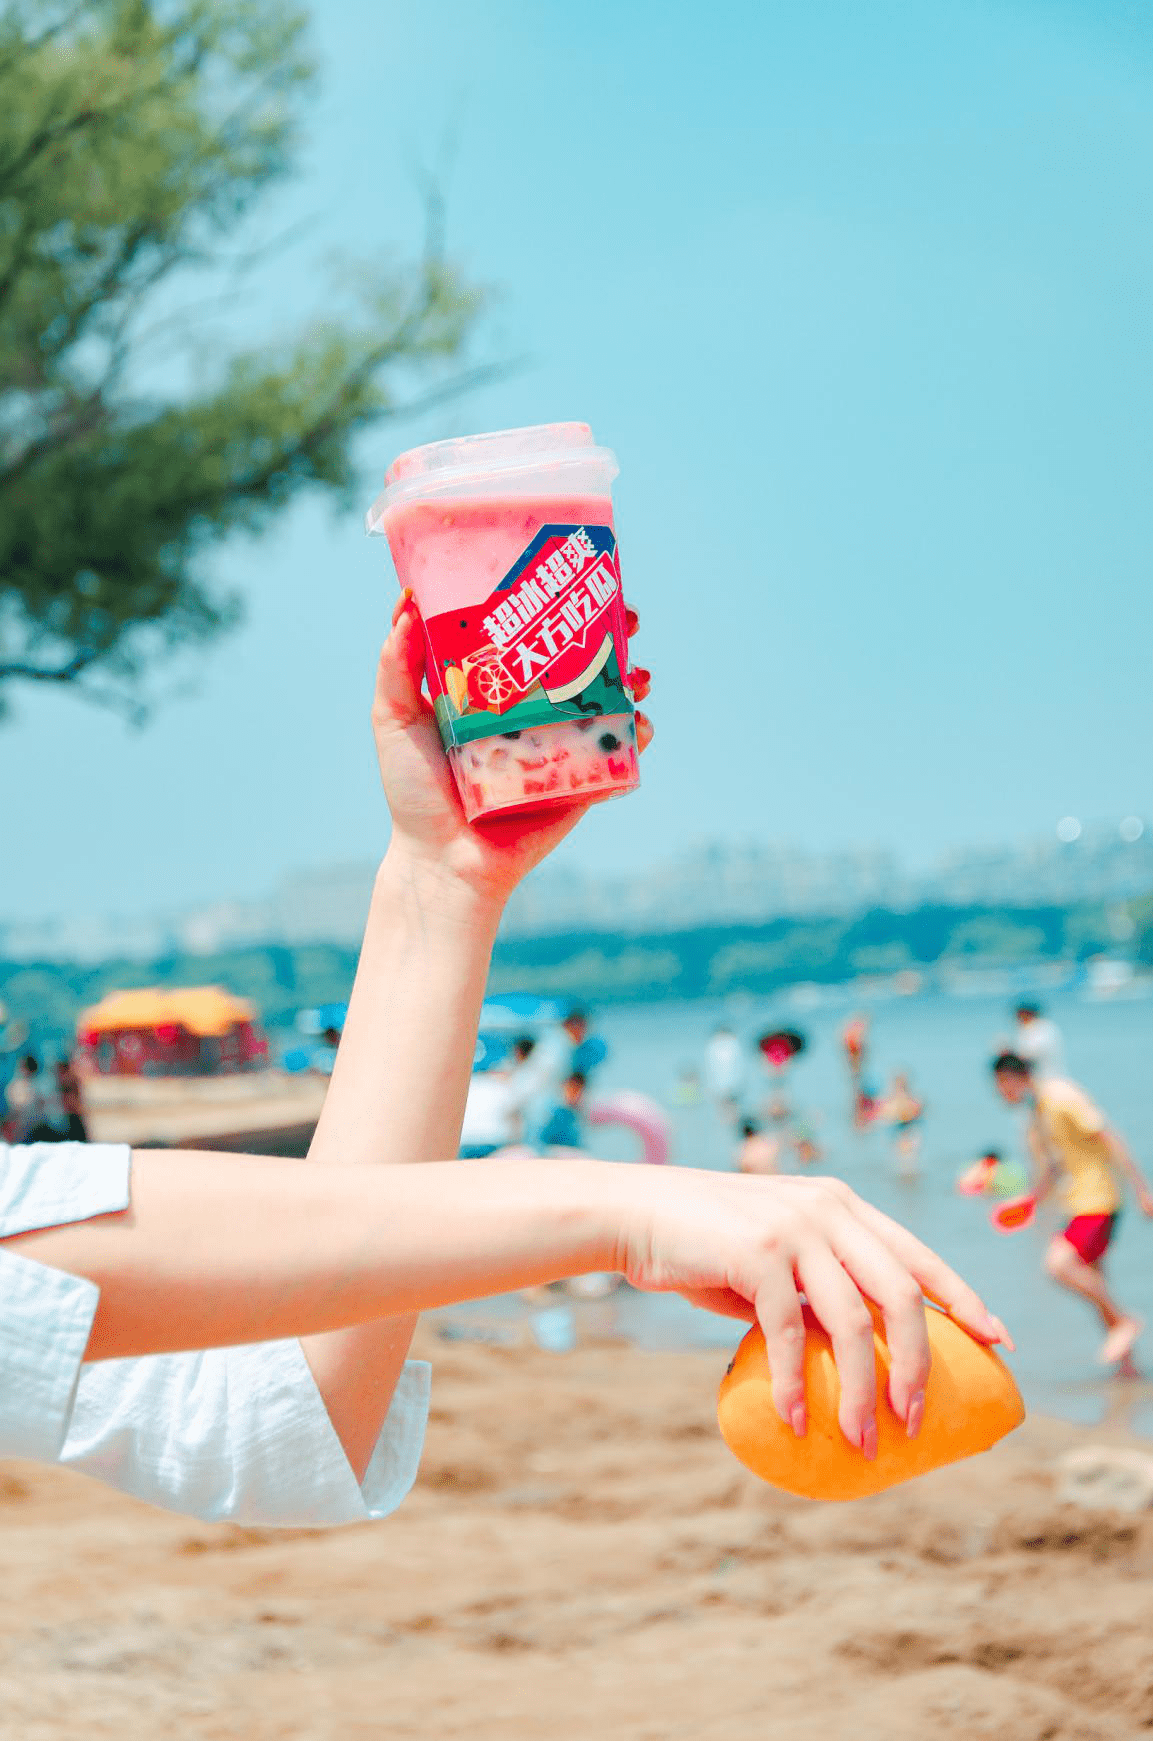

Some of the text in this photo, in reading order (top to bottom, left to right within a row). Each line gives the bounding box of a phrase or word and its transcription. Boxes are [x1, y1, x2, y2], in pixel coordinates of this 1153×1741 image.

[482, 526, 599, 648] 超冰超爽
[512, 561, 618, 683] 大方吃瓜
